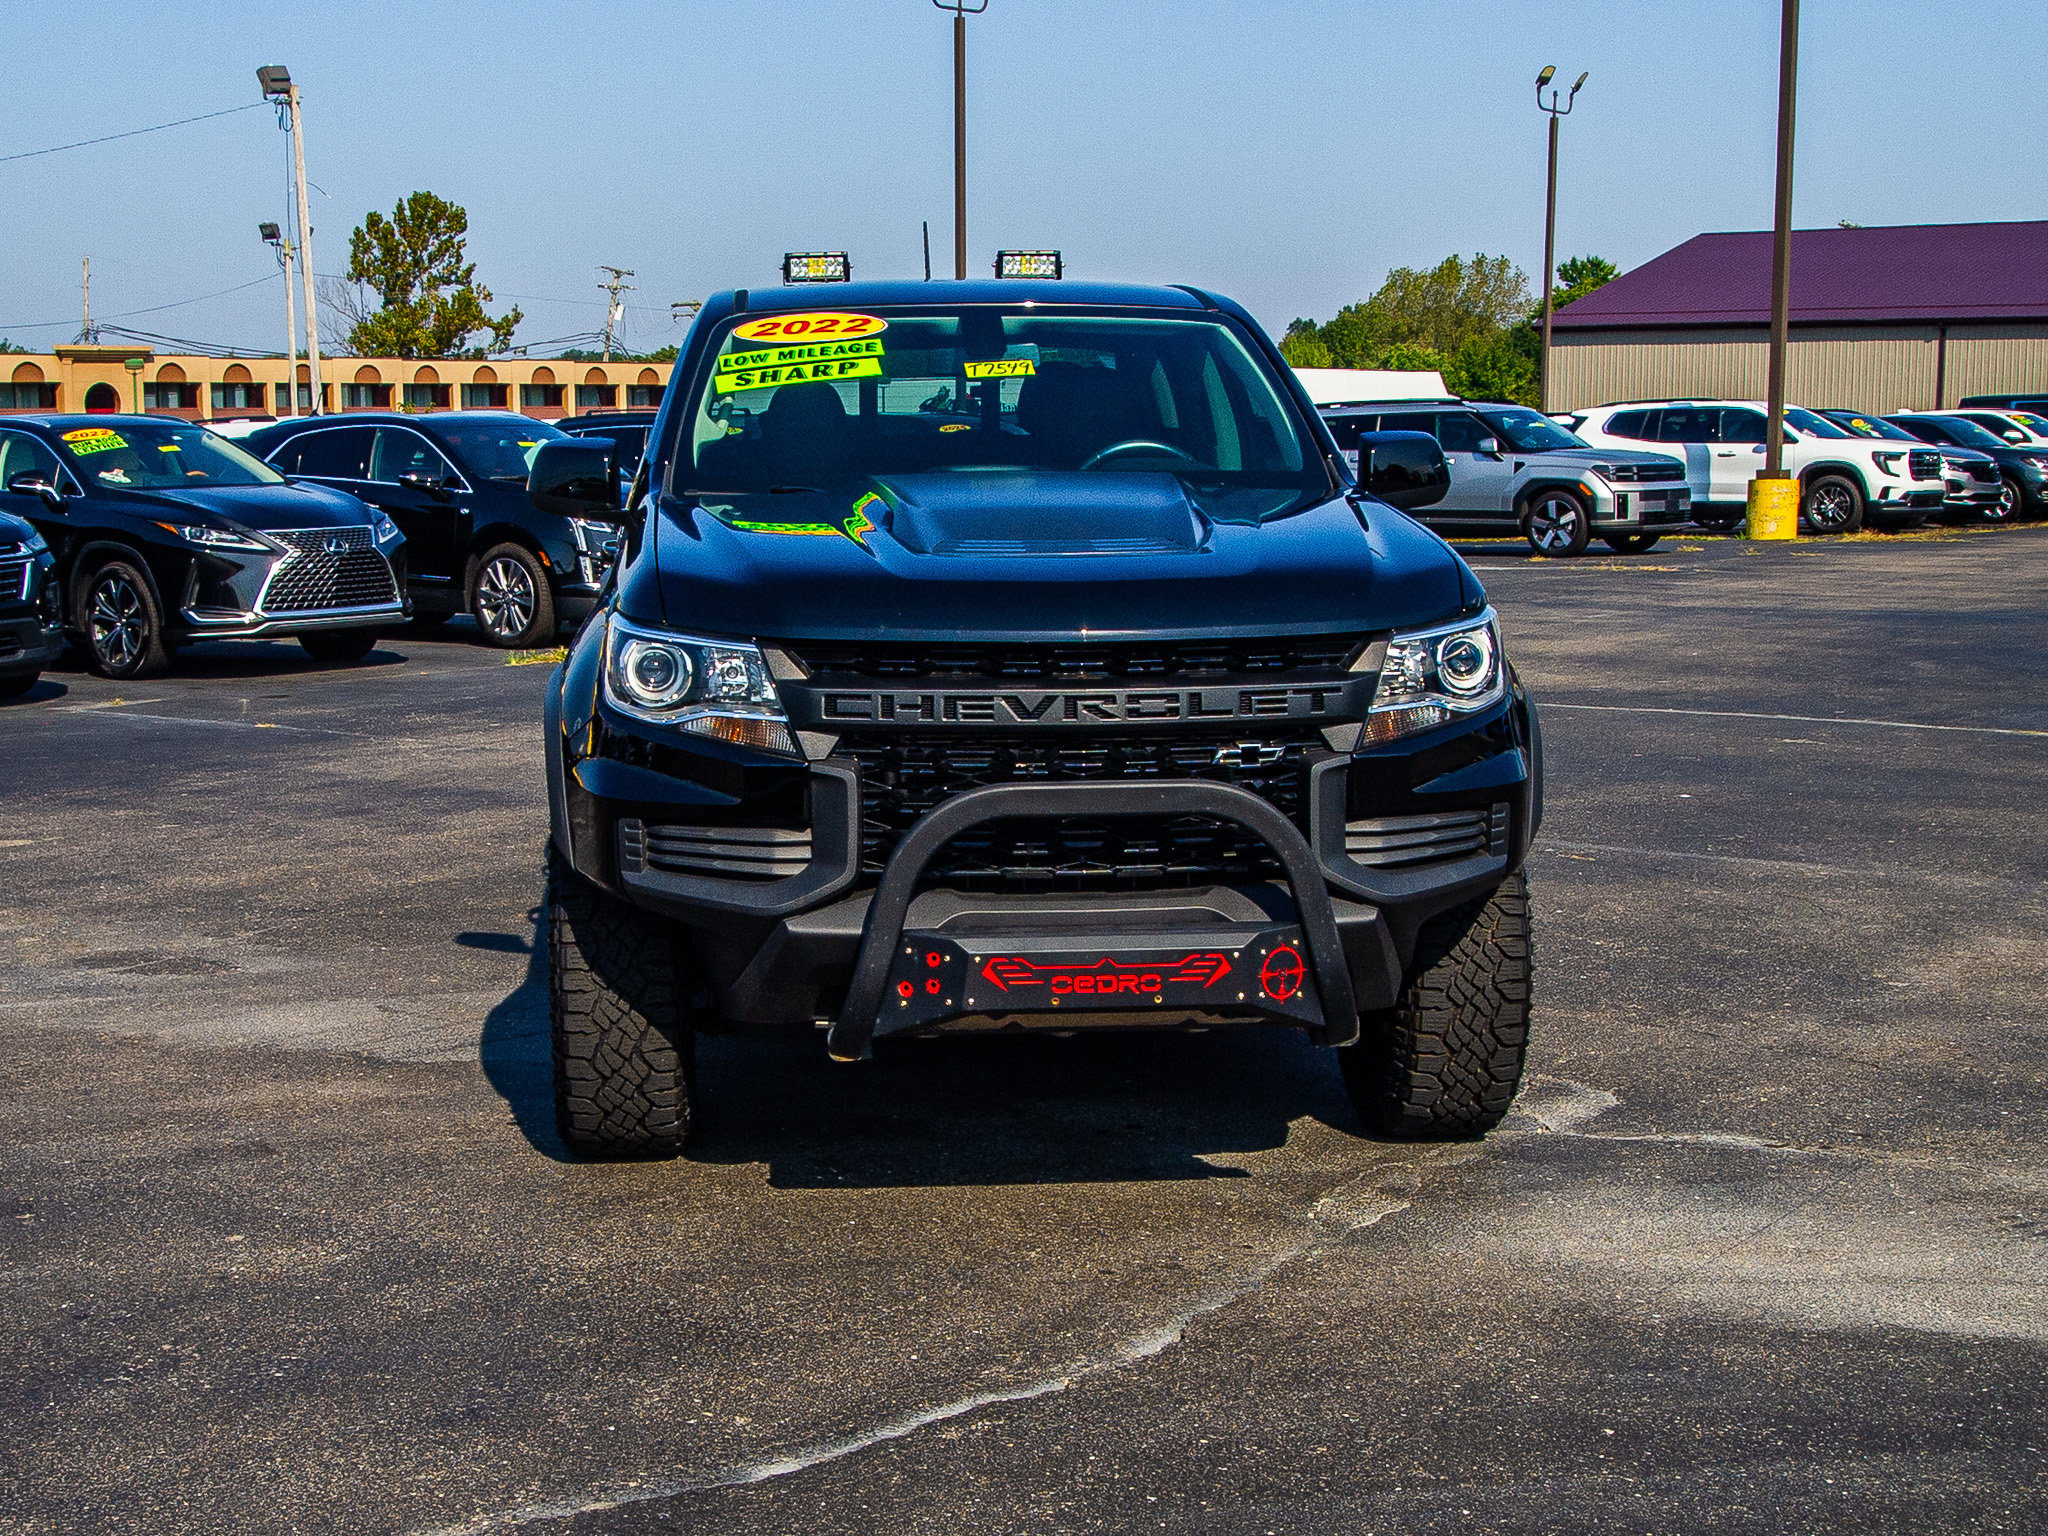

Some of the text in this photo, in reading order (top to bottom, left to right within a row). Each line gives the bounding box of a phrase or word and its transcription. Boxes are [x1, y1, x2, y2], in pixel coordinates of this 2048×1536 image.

[750, 318, 872, 338] 2022
[722, 341, 879, 368] LOW MILEAGE
[734, 361, 860, 387] SHARP
[967, 361, 1030, 377] T7549
[70, 430, 110, 440] 2022
[822, 686, 1343, 721] CHEVROLET
